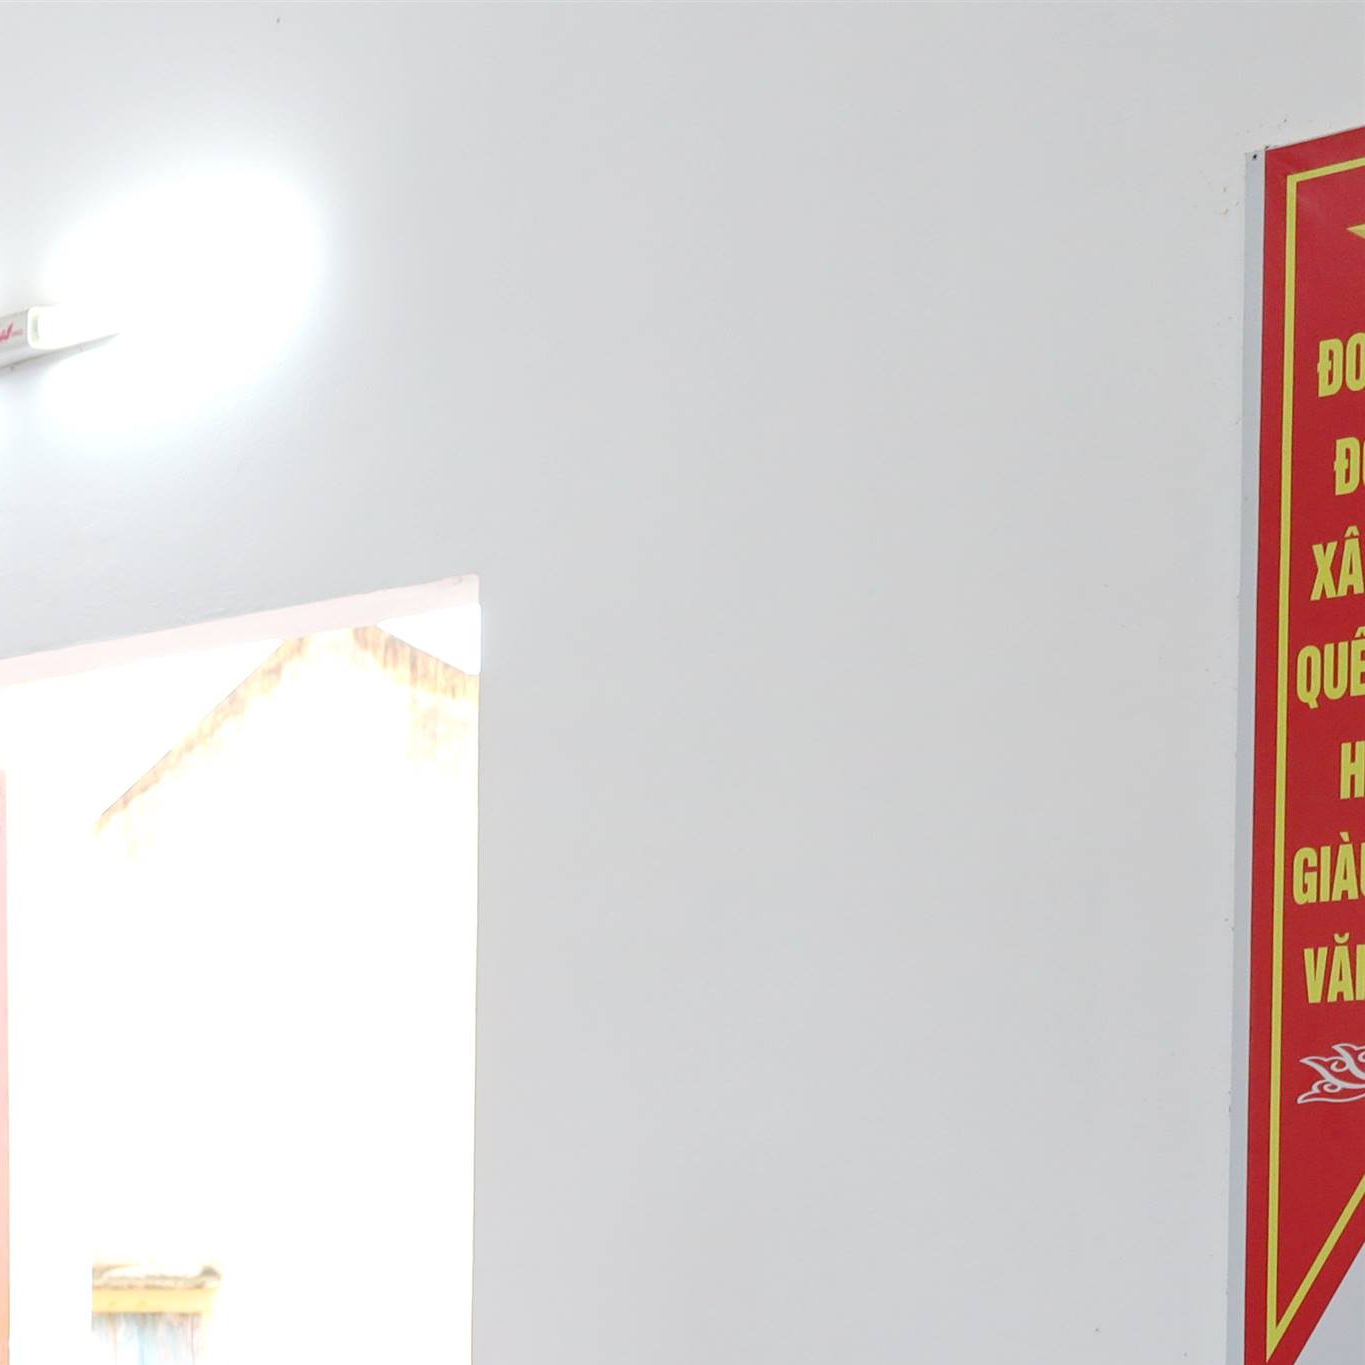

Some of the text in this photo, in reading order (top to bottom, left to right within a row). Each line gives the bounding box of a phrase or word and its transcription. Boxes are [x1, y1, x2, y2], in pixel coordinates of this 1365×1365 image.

[1333, 436, 1365, 496] Đ
[1310, 525, 1365, 601] XÂ
[1292, 830, 1365, 906] GIÀ
